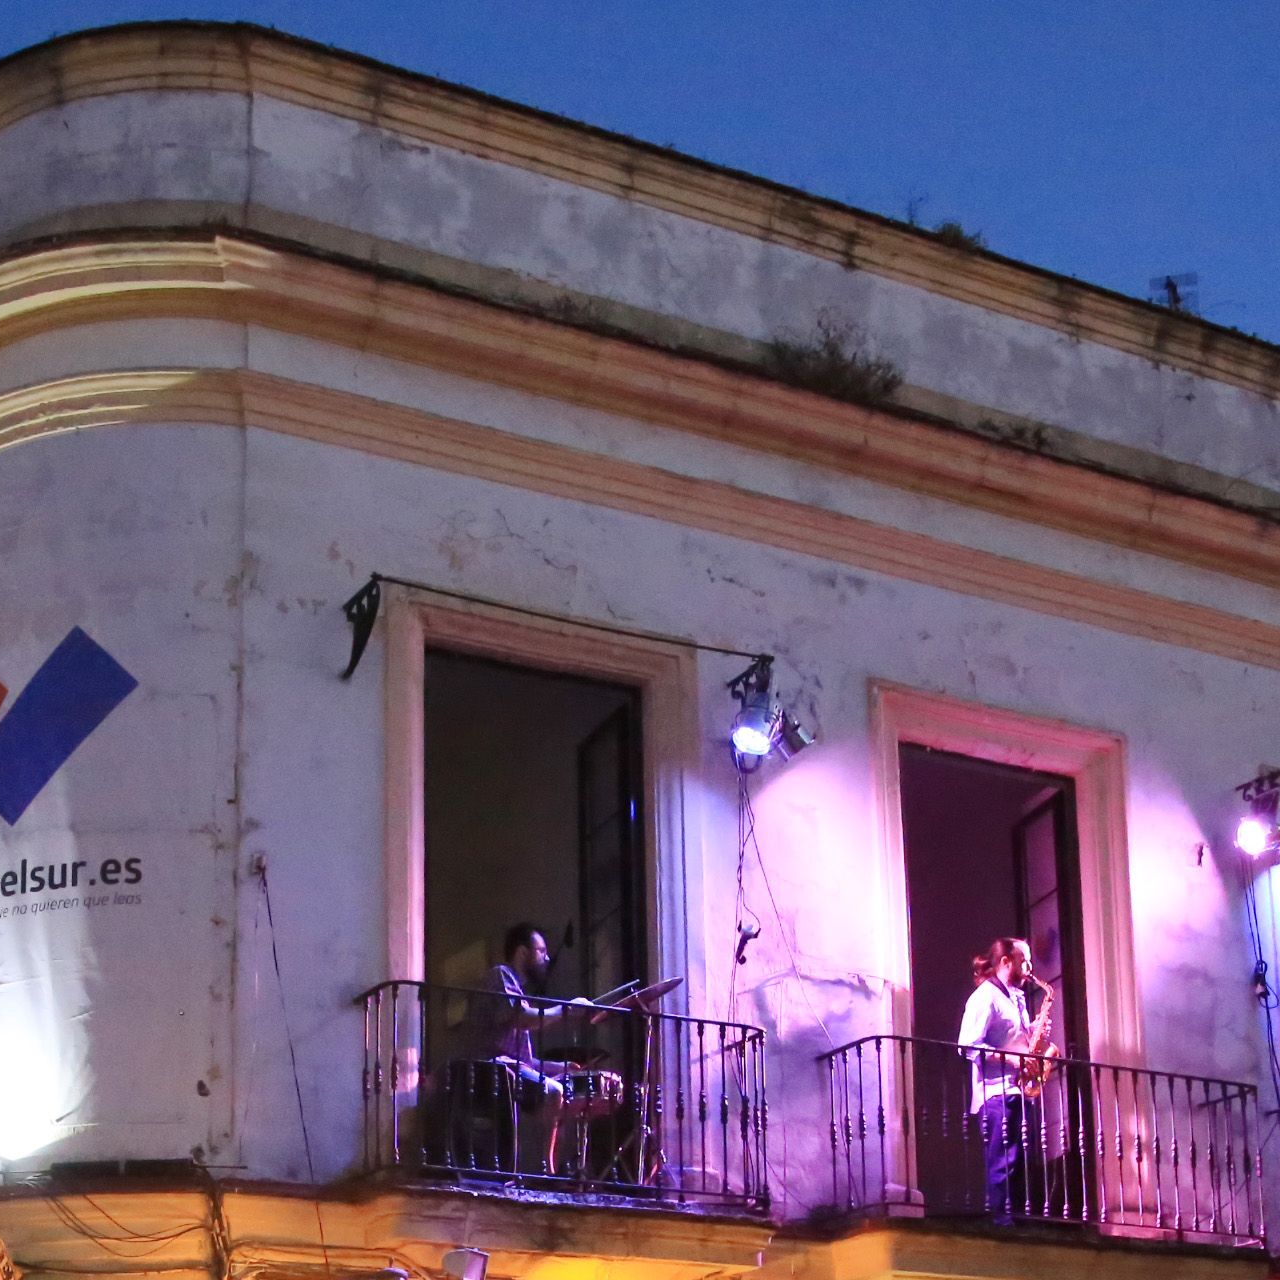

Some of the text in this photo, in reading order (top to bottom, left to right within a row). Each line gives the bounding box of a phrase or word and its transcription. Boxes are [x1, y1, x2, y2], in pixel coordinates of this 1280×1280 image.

[12, 904, 27, 916] no
[31, 898, 80, 915] quieren
[83, 895, 110, 909] que
